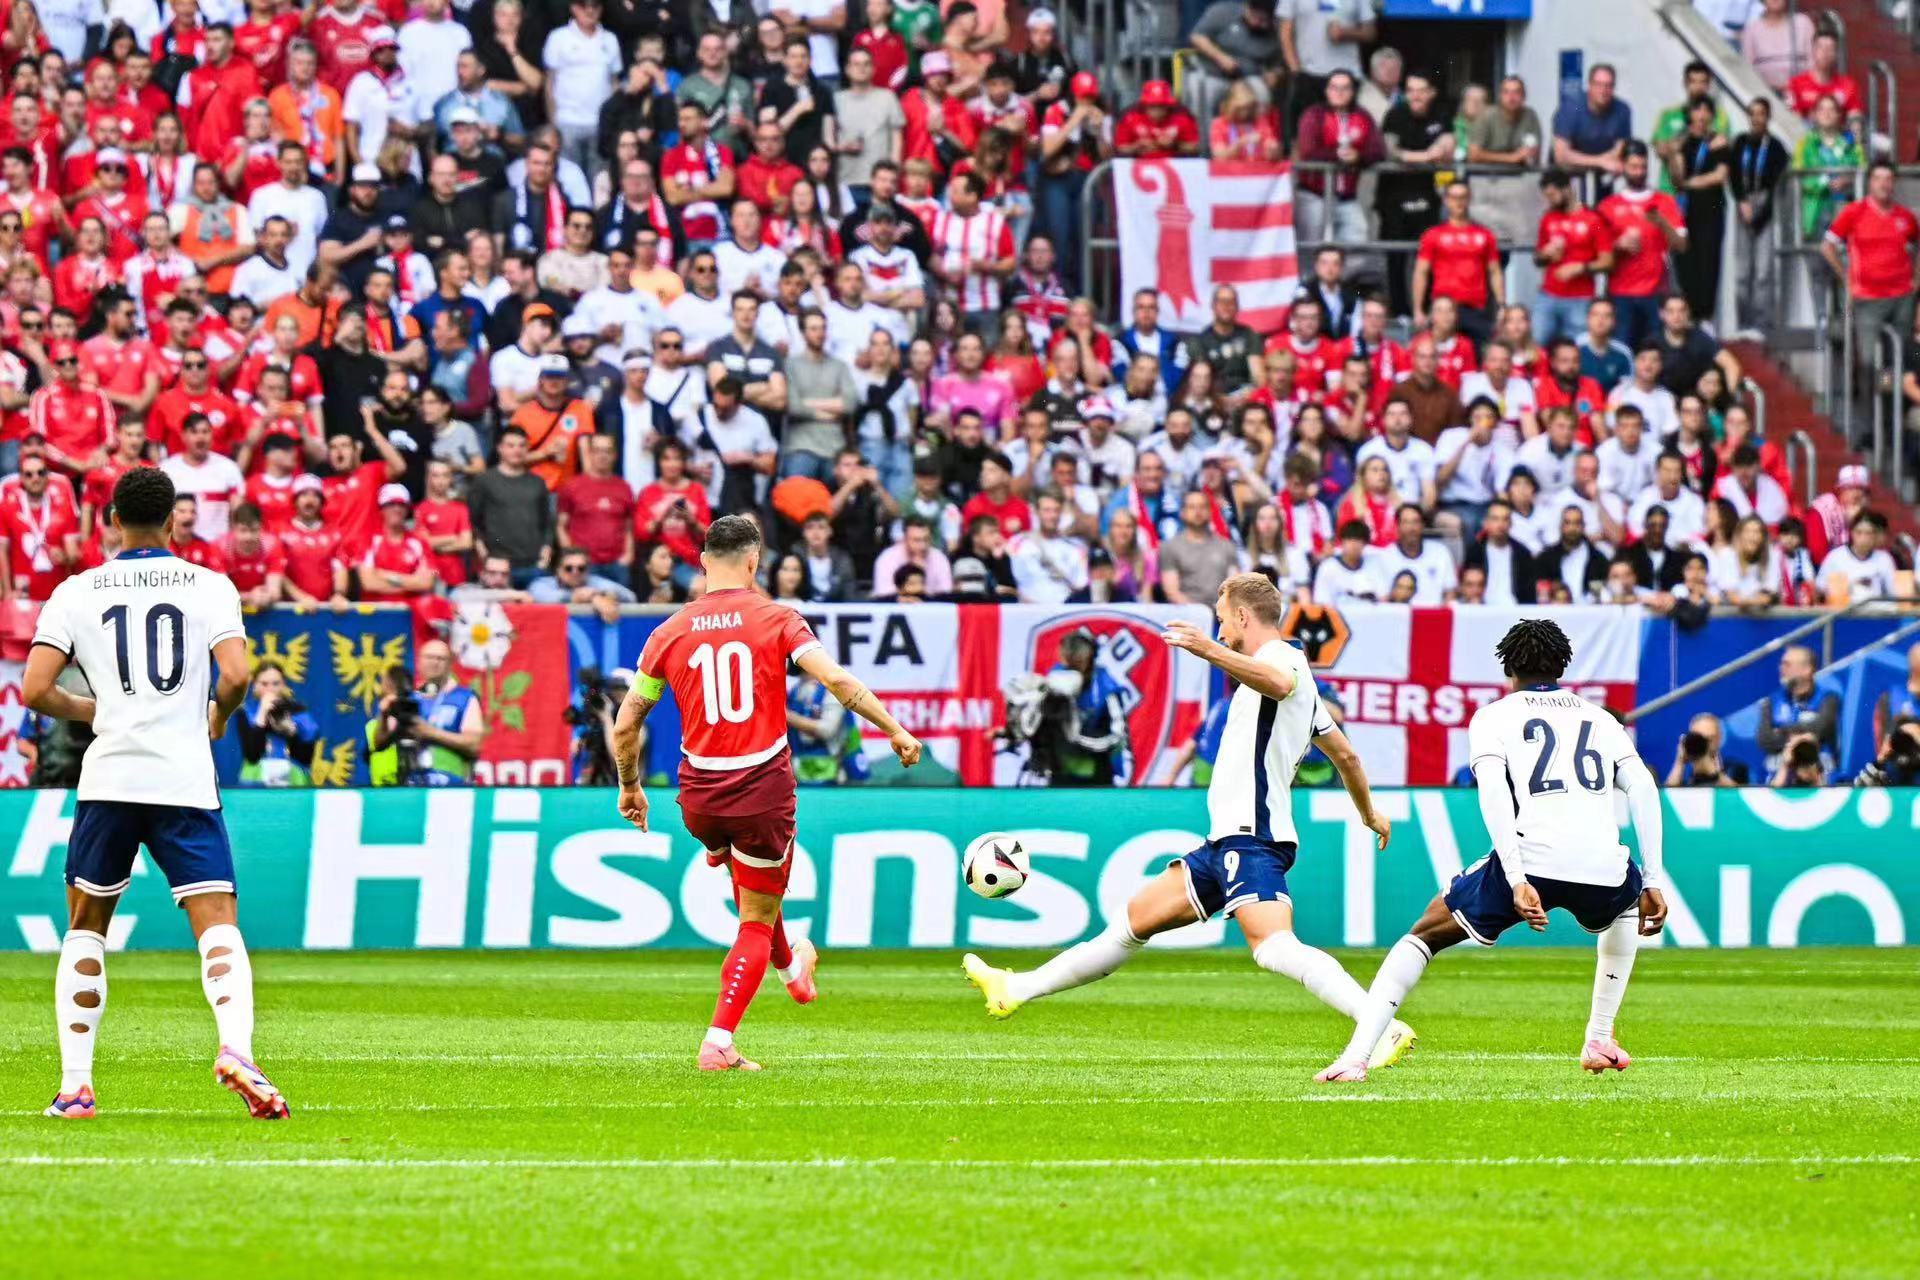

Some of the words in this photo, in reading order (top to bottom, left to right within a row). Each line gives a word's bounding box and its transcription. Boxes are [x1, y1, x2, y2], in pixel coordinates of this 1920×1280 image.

[94, 571, 195, 589] BELLINGHAM
[102, 603, 188, 695] 10
[691, 611, 743, 632] XHAKA
[688, 640, 754, 725] 10
[1523, 718, 1607, 797] 26
[1224, 850, 1240, 883] 9
